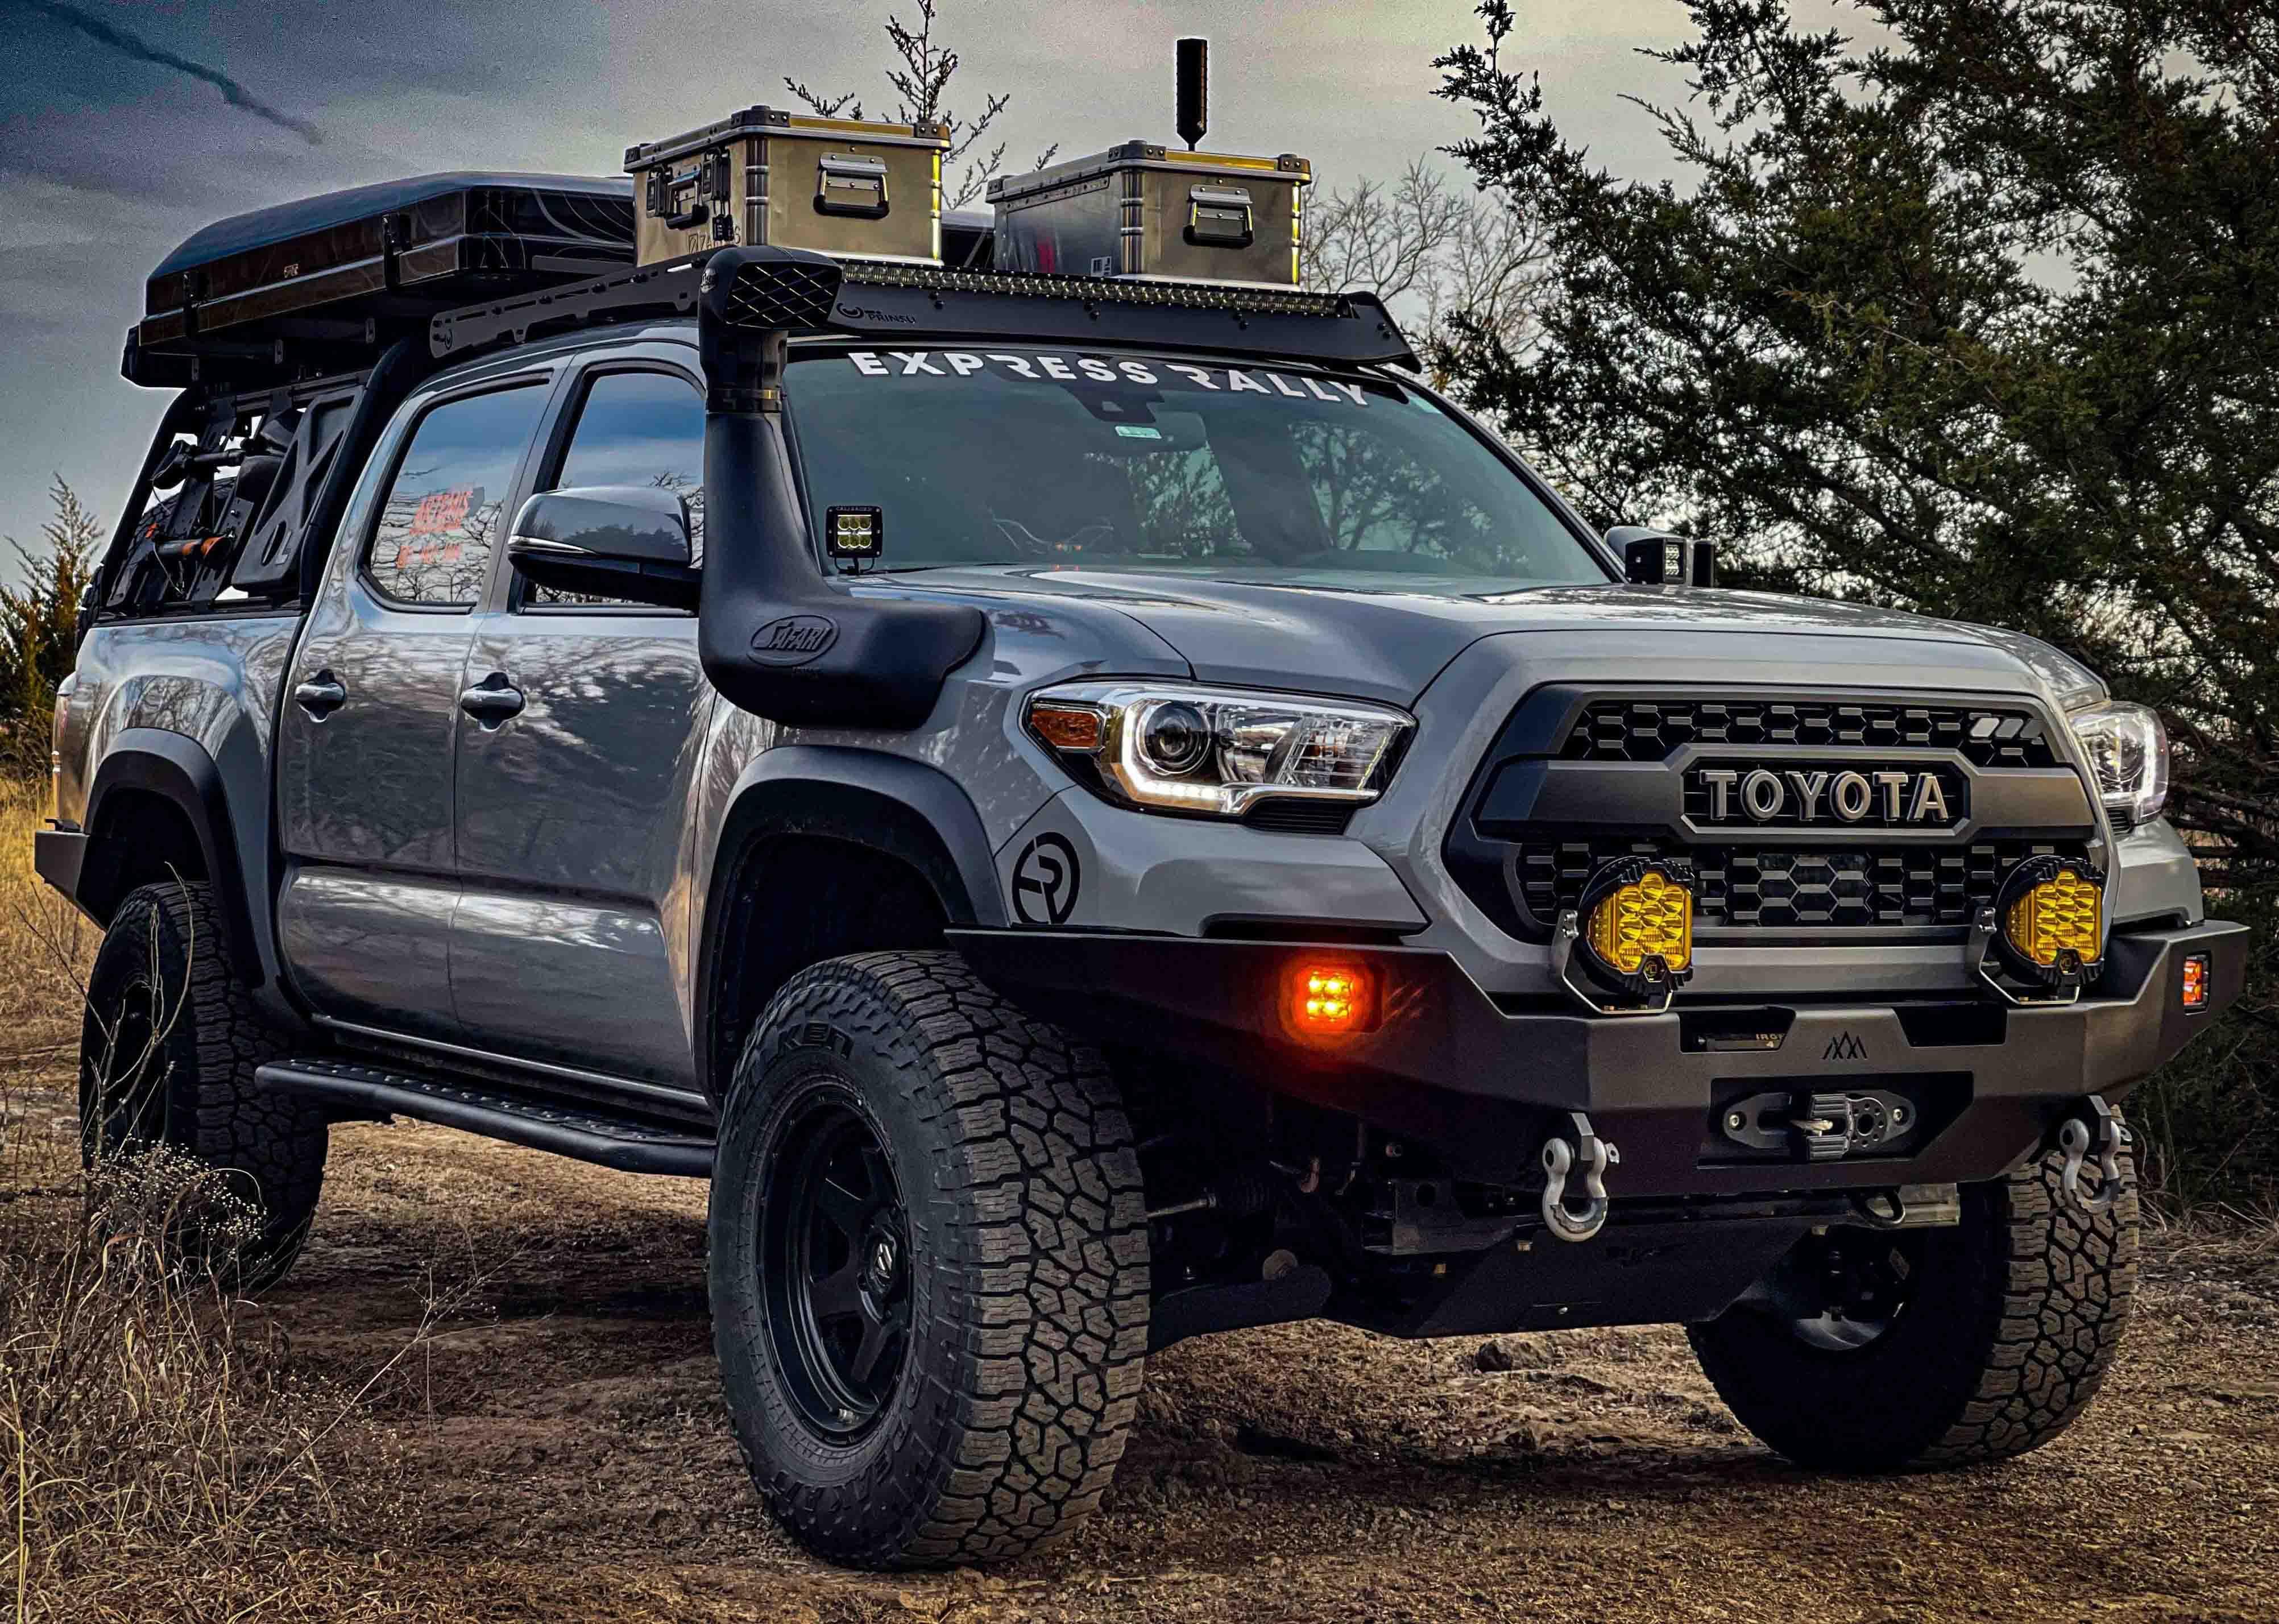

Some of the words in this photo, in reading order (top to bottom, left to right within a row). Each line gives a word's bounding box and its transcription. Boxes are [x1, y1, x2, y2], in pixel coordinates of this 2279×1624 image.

[868, 313, 916, 324] PRINSU
[847, 351, 1158, 384] EXPRESS
[1166, 364, 1369, 406] RALLY
[753, 621, 832, 652] SAFARI
[1699, 769, 1949, 822] TOYOTA
